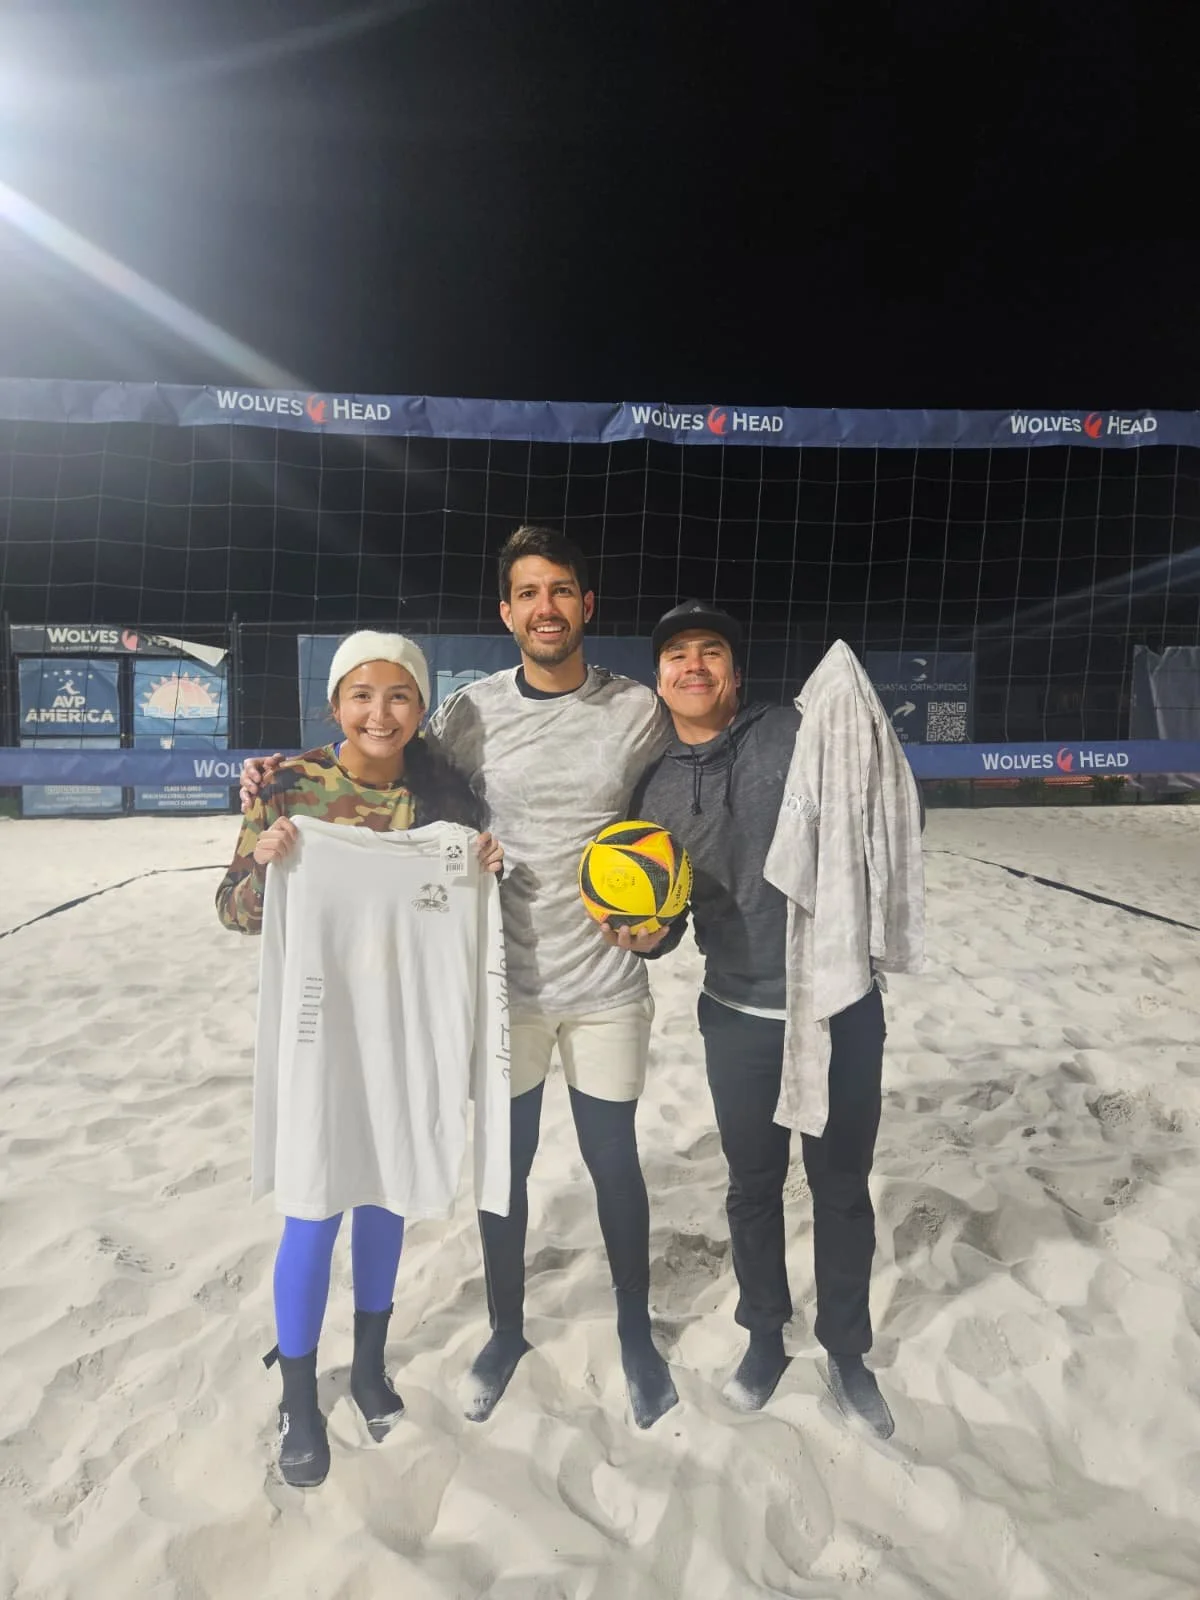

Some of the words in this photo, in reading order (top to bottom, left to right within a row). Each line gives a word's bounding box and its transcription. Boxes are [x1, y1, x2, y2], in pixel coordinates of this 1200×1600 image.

[217, 390, 304, 416] WOLVES
[333, 398, 391, 420] HEAD
[631, 406, 704, 430] WOLVES
[733, 411, 783, 432] HEAD
[1011, 415, 1082, 434] WOLVES
[1107, 416, 1157, 435] HEAD
[46, 627, 119, 644] WOLVES
[52, 696, 86, 708] AVP
[25, 708, 115, 723] AMERICA
[982, 752, 1053, 770] WOLVES
[1079, 751, 1129, 768] HEAD
